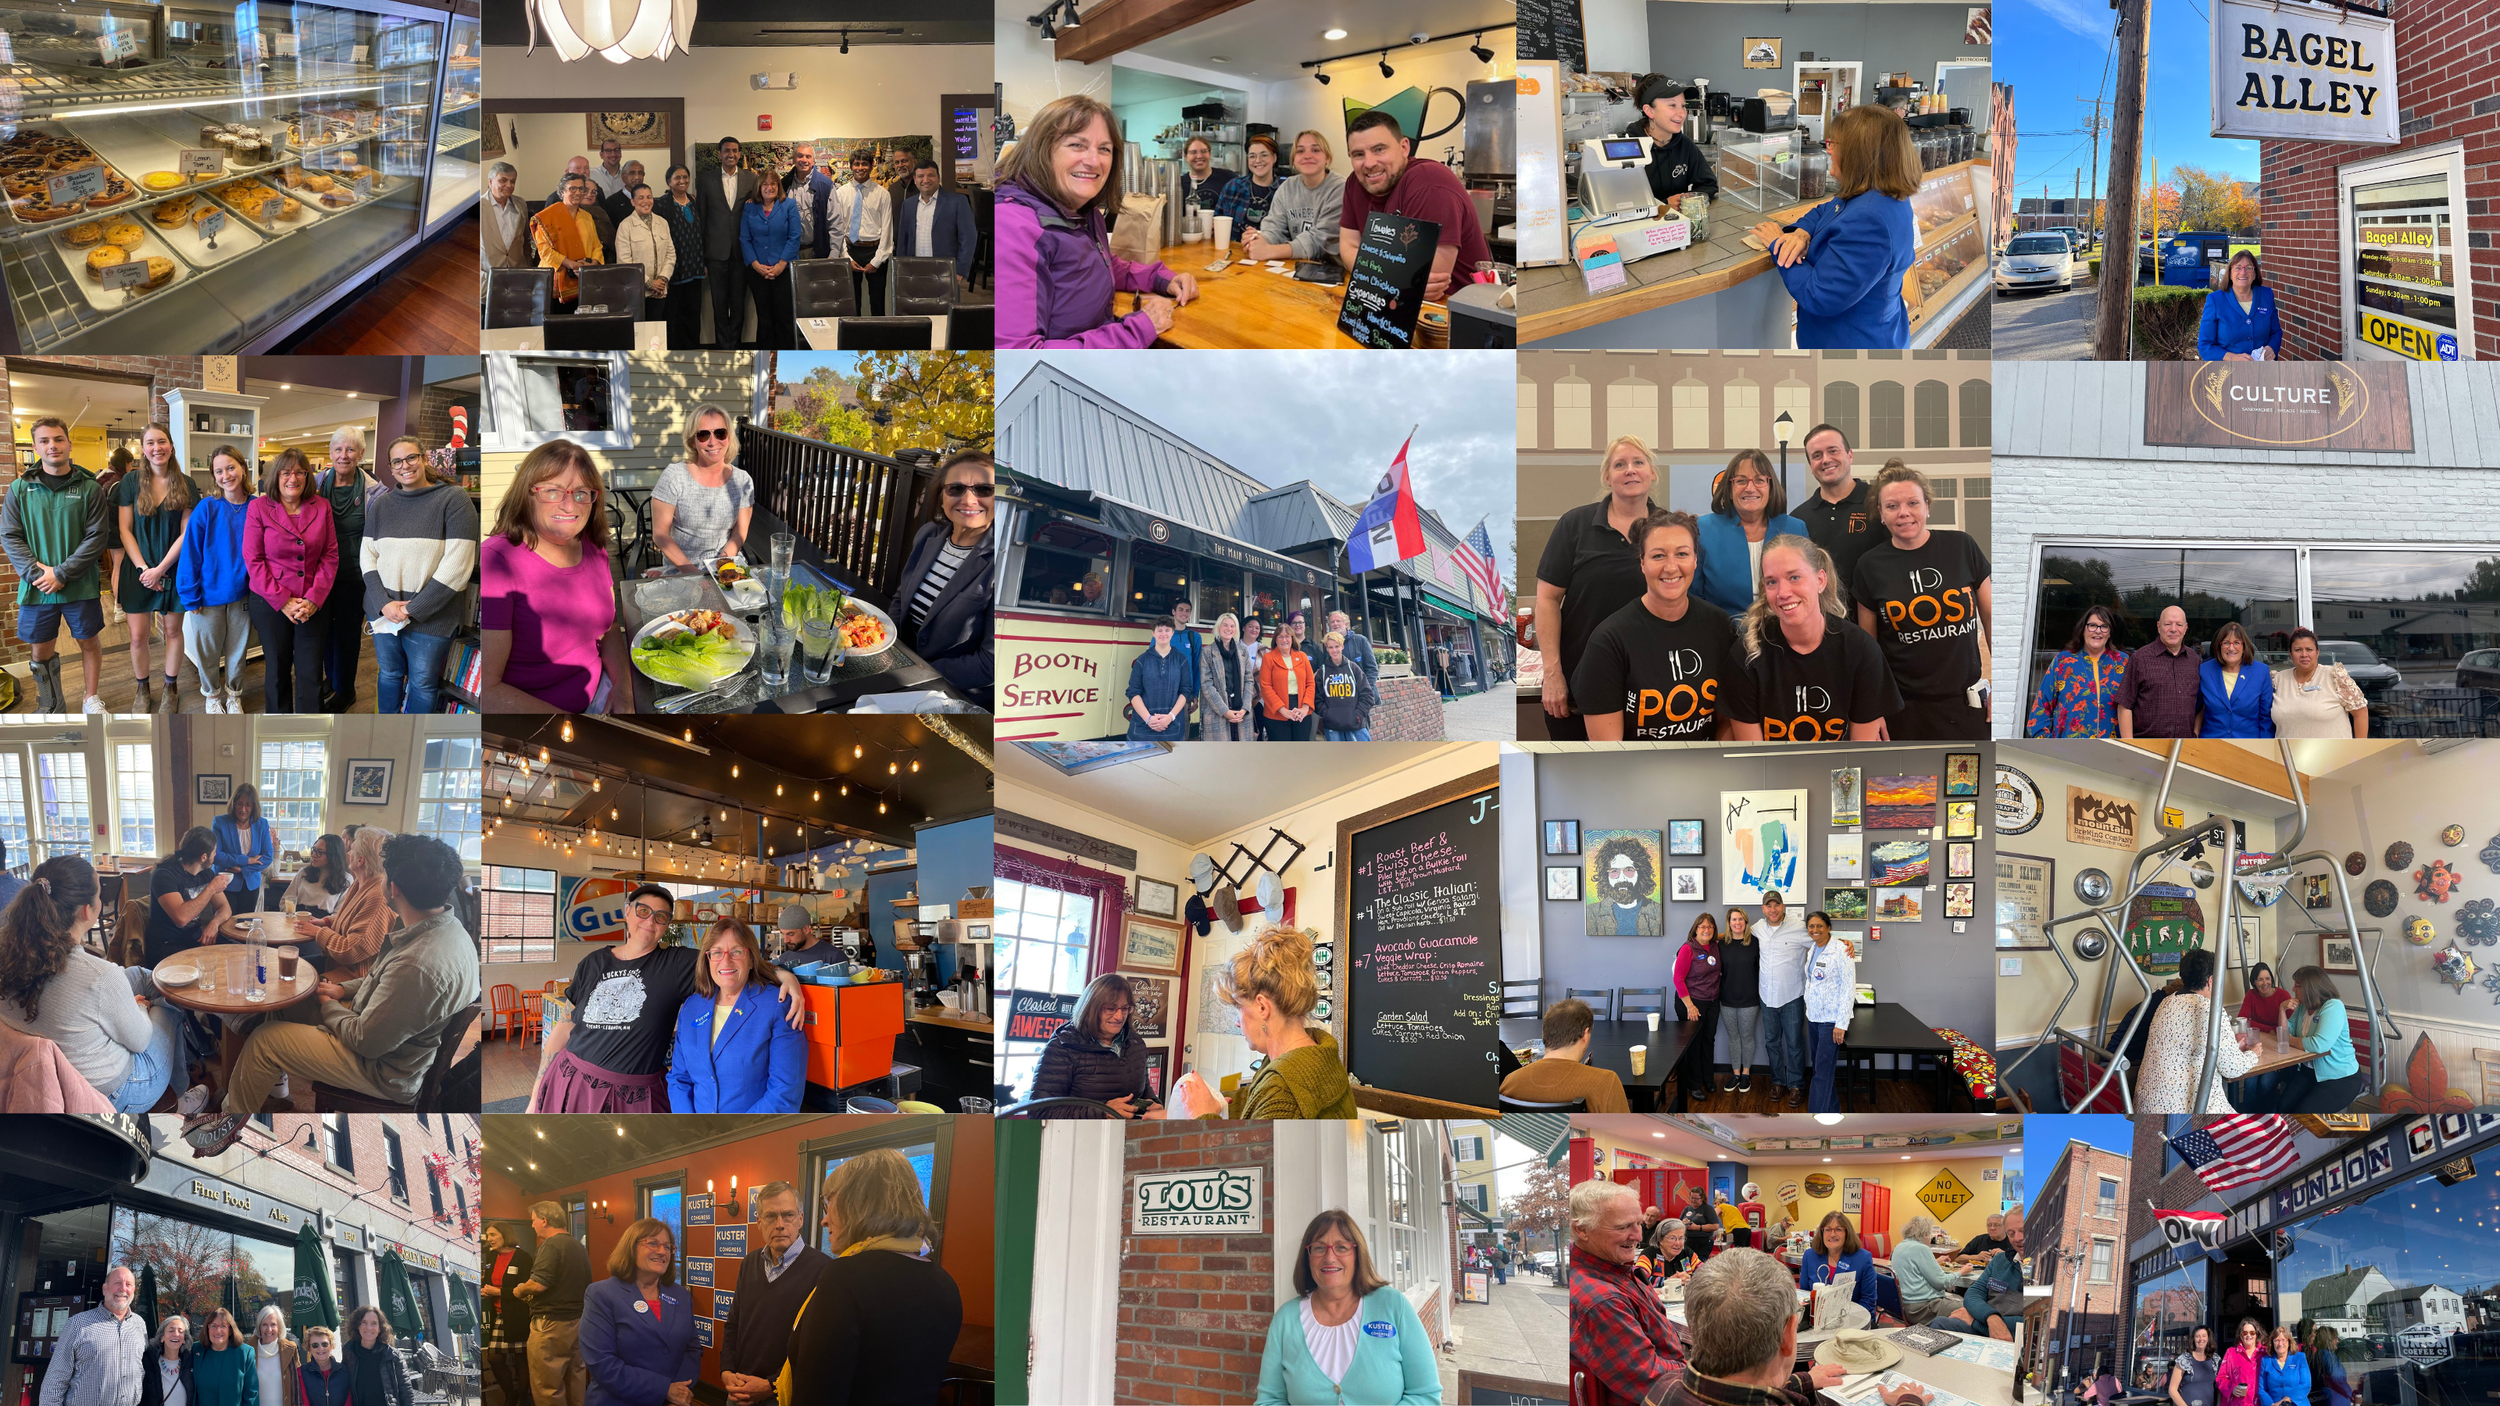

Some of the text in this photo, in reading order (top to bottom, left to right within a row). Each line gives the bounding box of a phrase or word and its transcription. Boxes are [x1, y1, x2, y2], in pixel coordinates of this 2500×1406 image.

[2241, 22, 2376, 77] BAGEL
[2237, 71, 2380, 118] ALLEY
[954, 135, 972, 143] Winter
[957, 144, 973, 154] Lager
[66, 171, 95, 183] Blueberry
[1370, 217, 1396, 237] Tamales
[2366, 231, 2433, 248] Bagel Alley
[1360, 242, 1379, 255] Cheese
[1357, 256, 1384, 274] Red Pork
[1352, 268, 1400, 296] Green Chicken
[2363, 268, 2389, 280] Saturday:
[1348, 280, 1386, 307] Empanadas
[2365, 286, 2387, 297] Sunday:
[1345, 299, 1363, 316] Beef
[1383, 321, 1409, 343] Cheese
[2370, 318, 2432, 360] OPEN
[2440, 343, 2455, 356] ADT
[2230, 385, 2331, 404] CULTURE
[1214, 542, 1284, 573] THE MAIN STREET STATION
[1885, 586, 1975, 631] POST
[1897, 618, 1977, 644] RESTAURANT
[1013, 653, 1098, 679] BOOTH
[1002, 683, 1099, 707] SERVICE
[1329, 684, 1352, 697] MOB
[1626, 690, 1637, 714] THE
[1638, 678, 1718, 727] POS
[1637, 715, 1713, 740] RESTAURA
[1764, 715, 1845, 741] POS
[2074, 794, 2137, 831] MOAT
[997, 817, 1030, 833] own
[2077, 819, 2131, 835] mountain
[2214, 829, 2242, 844] STK
[1376, 831, 1448, 863] Roast Beef &
[1377, 845, 1457, 873] Swiss Cheese:
[1395, 868, 1408, 879] high
[1452, 854, 1468, 863] roll
[1358, 861, 1373, 877] #1
[1395, 876, 1411, 885] Spicy
[1413, 871, 1433, 880] Brown
[1374, 881, 1478, 909] The Classic Italian:
[1427, 898, 1450, 907] Genoa
[1424, 904, 1451, 913] Virginia
[1374, 935, 1478, 953] Avocado Guacamole
[1315, 951, 1328, 961] NH
[1354, 953, 1371, 970] #7
[1375, 953, 1402, 967] Veggie
[1439, 962, 1456, 970] Crisp
[1457, 960, 1484, 968] Romaine
[1135, 980, 1161, 992] Chocolate
[1017, 996, 1072, 1013] Closed BUT
[1463, 994, 1500, 1004] Dressings
[1315, 1003, 1328, 1015] NH
[1377, 1010, 1428, 1022] Garden Salad
[1453, 1009, 1466, 1017] Add
[1133, 1020, 1159, 1031] Chocolate
[1472, 1017, 1492, 1026] Jerk
[1426, 1031, 1440, 1039] Red
[1442, 1033, 1466, 1041] Onion
[100, 1113, 115, 1124] &
[120, 1114, 151, 1156] Tavern
[197, 1118, 235, 1146] HOUSE
[2292, 1143, 2391, 1208] UNION
[1139, 1170, 1252, 1212] LOU'S
[1845, 1182, 1860, 1191] LEFT
[1936, 1180, 1952, 1190] NO
[193, 1180, 251, 1210] Fine Food
[1923, 1192, 1966, 1204] OUTLET
[688, 1199, 714, 1211] KUSTER
[269, 1207, 290, 1223] Ales
[690, 1214, 711, 1222] CONGRESS
[1142, 1215, 1250, 1226] RESTAURANT
[716, 1230, 746, 1241] KUSTER
[218, 1257, 249, 1273] OPEN
[421, 1254, 439, 1270] HOUSE
[688, 1262, 714, 1272] KUSTER
[690, 1275, 711, 1283] CONGRESS
[715, 1294, 734, 1305] KUST
[1368, 1323, 1393, 1331] KUSTER
[2403, 1348, 2435, 1356] COFFEE
[1510, 1395, 1544, 1406] HOT
